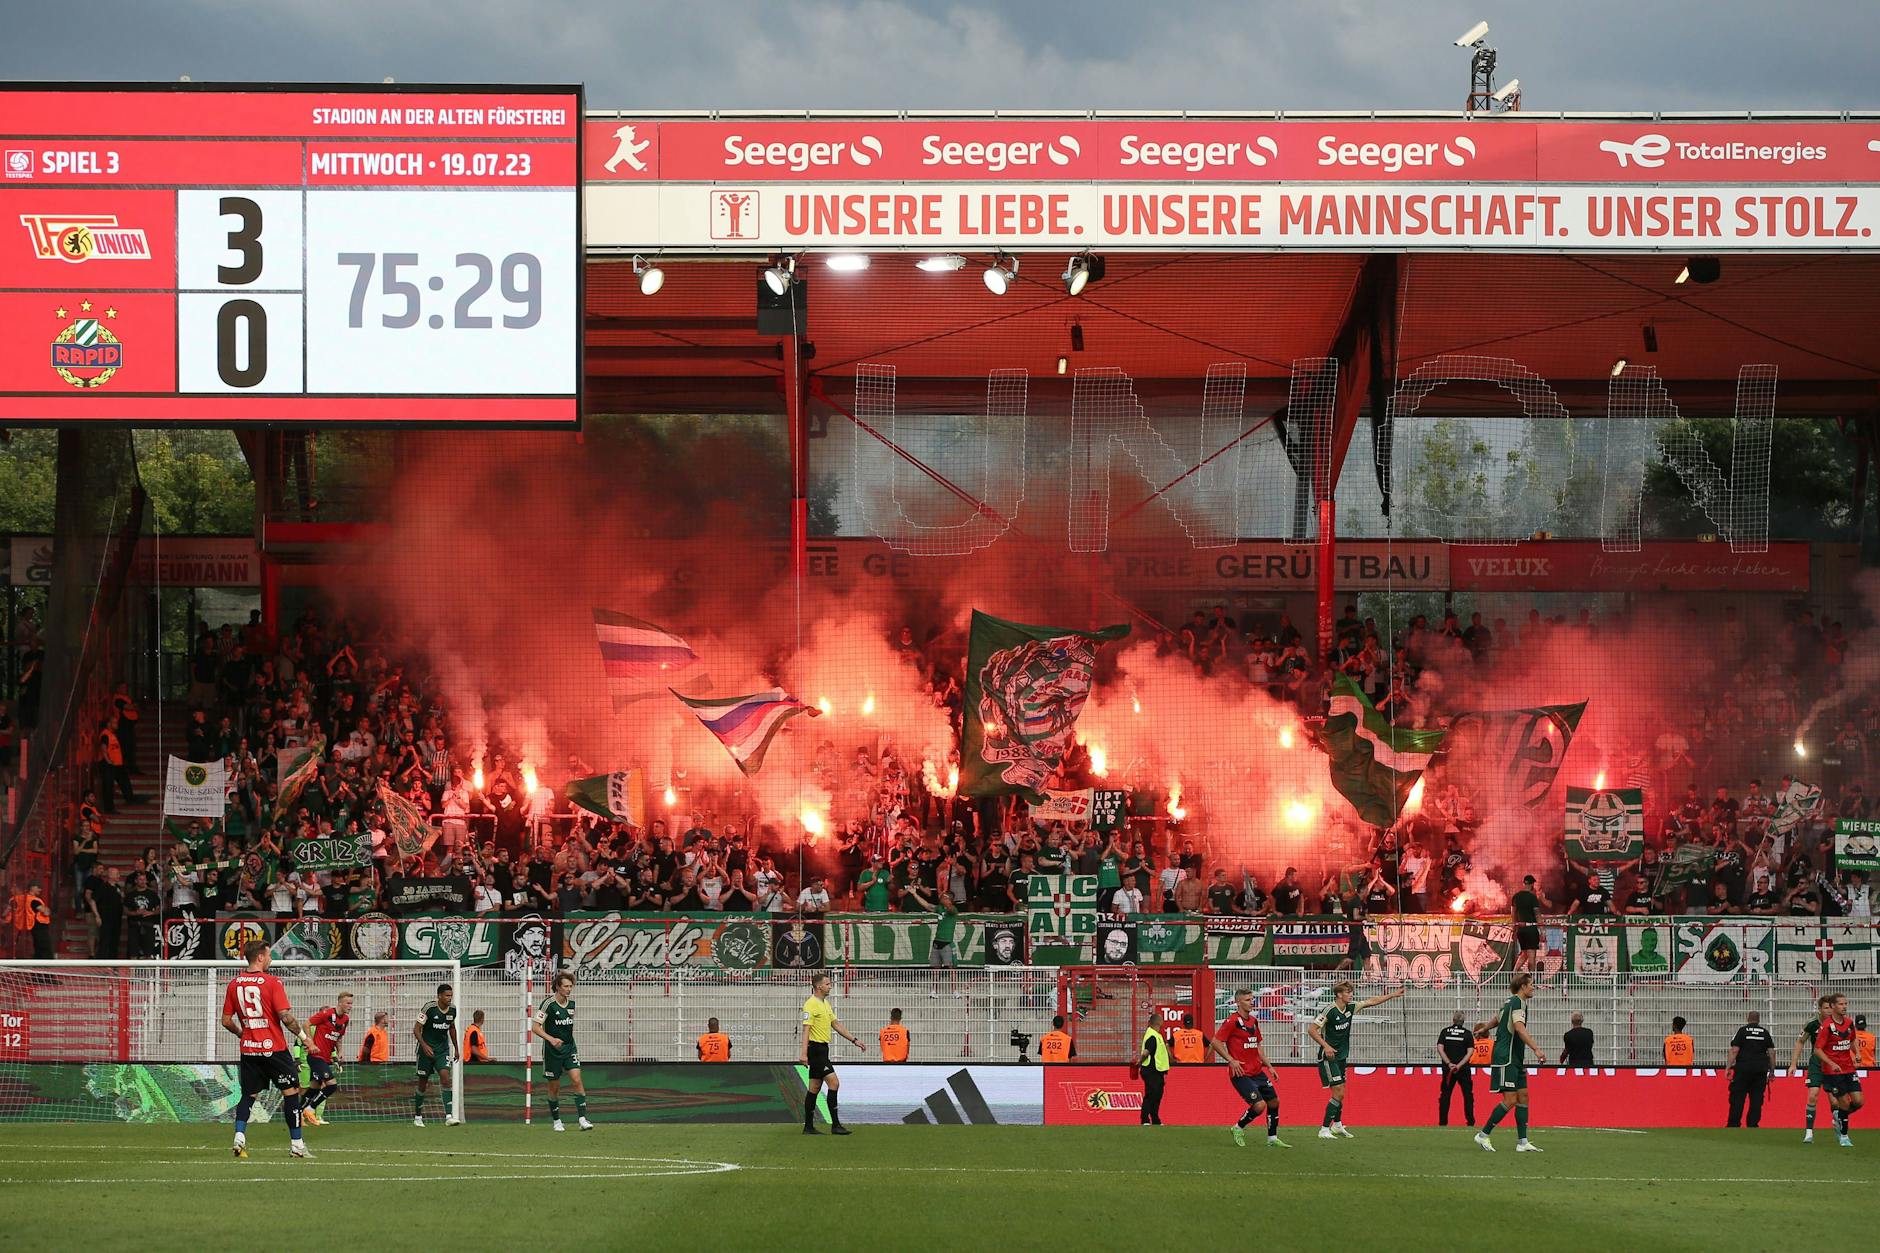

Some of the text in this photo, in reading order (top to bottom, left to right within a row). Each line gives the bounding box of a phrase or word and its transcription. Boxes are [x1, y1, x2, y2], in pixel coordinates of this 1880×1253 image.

[312, 106, 566, 126] STADION AN DER ALTEN FÖRSTEREI
[42, 151, 120, 174] SPIEL 3
[724, 135, 846, 172] Seeger
[922, 135, 1044, 172] Seeger
[1119, 135, 1241, 172] Seeger
[1317, 135, 1439, 173] Seeger
[1675, 141, 1826, 165] TotalEnergies
[312, 153, 531, 176] MITTWOCH 19.07.23
[784, 194, 1872, 238] UNSERE LIEBE. UNSERE MANNSCHAFT. UNSER STOLZ.
[94, 231, 149, 255] UNION
[216, 196, 264, 287] 3
[337, 251, 544, 330] 75:29
[216, 298, 268, 389] 0
[54, 346, 120, 366] RAPID
[141, 562, 249, 582] EUMANN
[1215, 549, 1431, 579] GERÜTBAU
[1467, 558, 1549, 577] VELUX
[995, 747, 1031, 760] 1988
[1842, 820, 1880, 832] WIENER
[1577, 918, 1617, 935] SAF
[569, 911, 704, 969] Lords
[1795, 959, 1856, 973] R W
[236, 985, 264, 1018] 19
[1, 1013, 24, 1027] Tor
[555, 1018, 573, 1026] wefo
[1161, 1007, 1185, 1021] Tor
[3, 1033, 21, 1047] 12
[243, 1039, 263, 1048] Allianz
[707, 1042, 720, 1051] 75
[884, 1033, 900, 1042] 259
[1046, 1041, 1063, 1050] 282
[1181, 1037, 1197, 1045] 110
